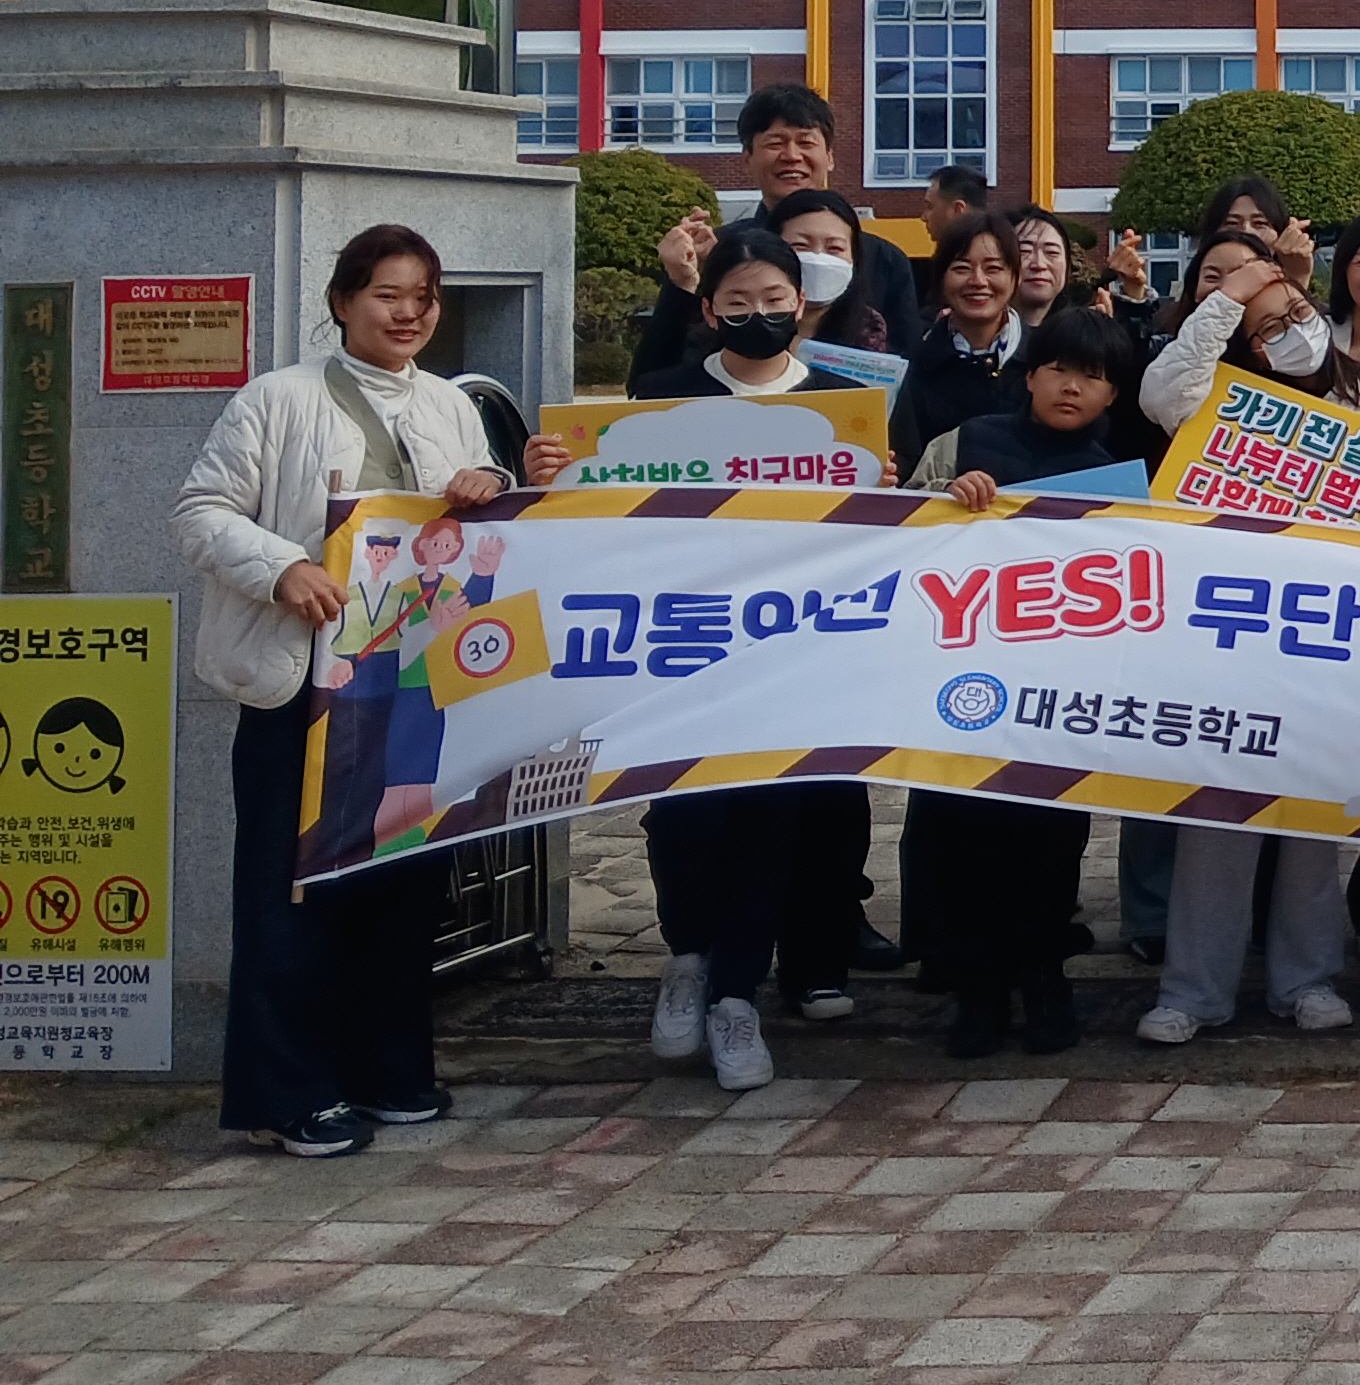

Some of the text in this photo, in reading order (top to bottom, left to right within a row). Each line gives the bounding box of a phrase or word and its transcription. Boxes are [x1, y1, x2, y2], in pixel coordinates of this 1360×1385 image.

[131, 285, 167, 299] CCTV
[19, 297, 56, 579] 대성초등학교
[1217, 382, 1302, 442] 가기
[1297, 411, 1346, 457] 전
[1203, 424, 1320, 497] 나부터
[914, 544, 1165, 649] YES!
[466, 634, 500, 663] 30
[1013, 686, 1283, 759] 대성초등학교
[17, 850, 83, 865] 지역입니다.
[30, 938, 146, 952] 유해시설 유해행위
[0, 963, 150, 987] 으로부터 200M
